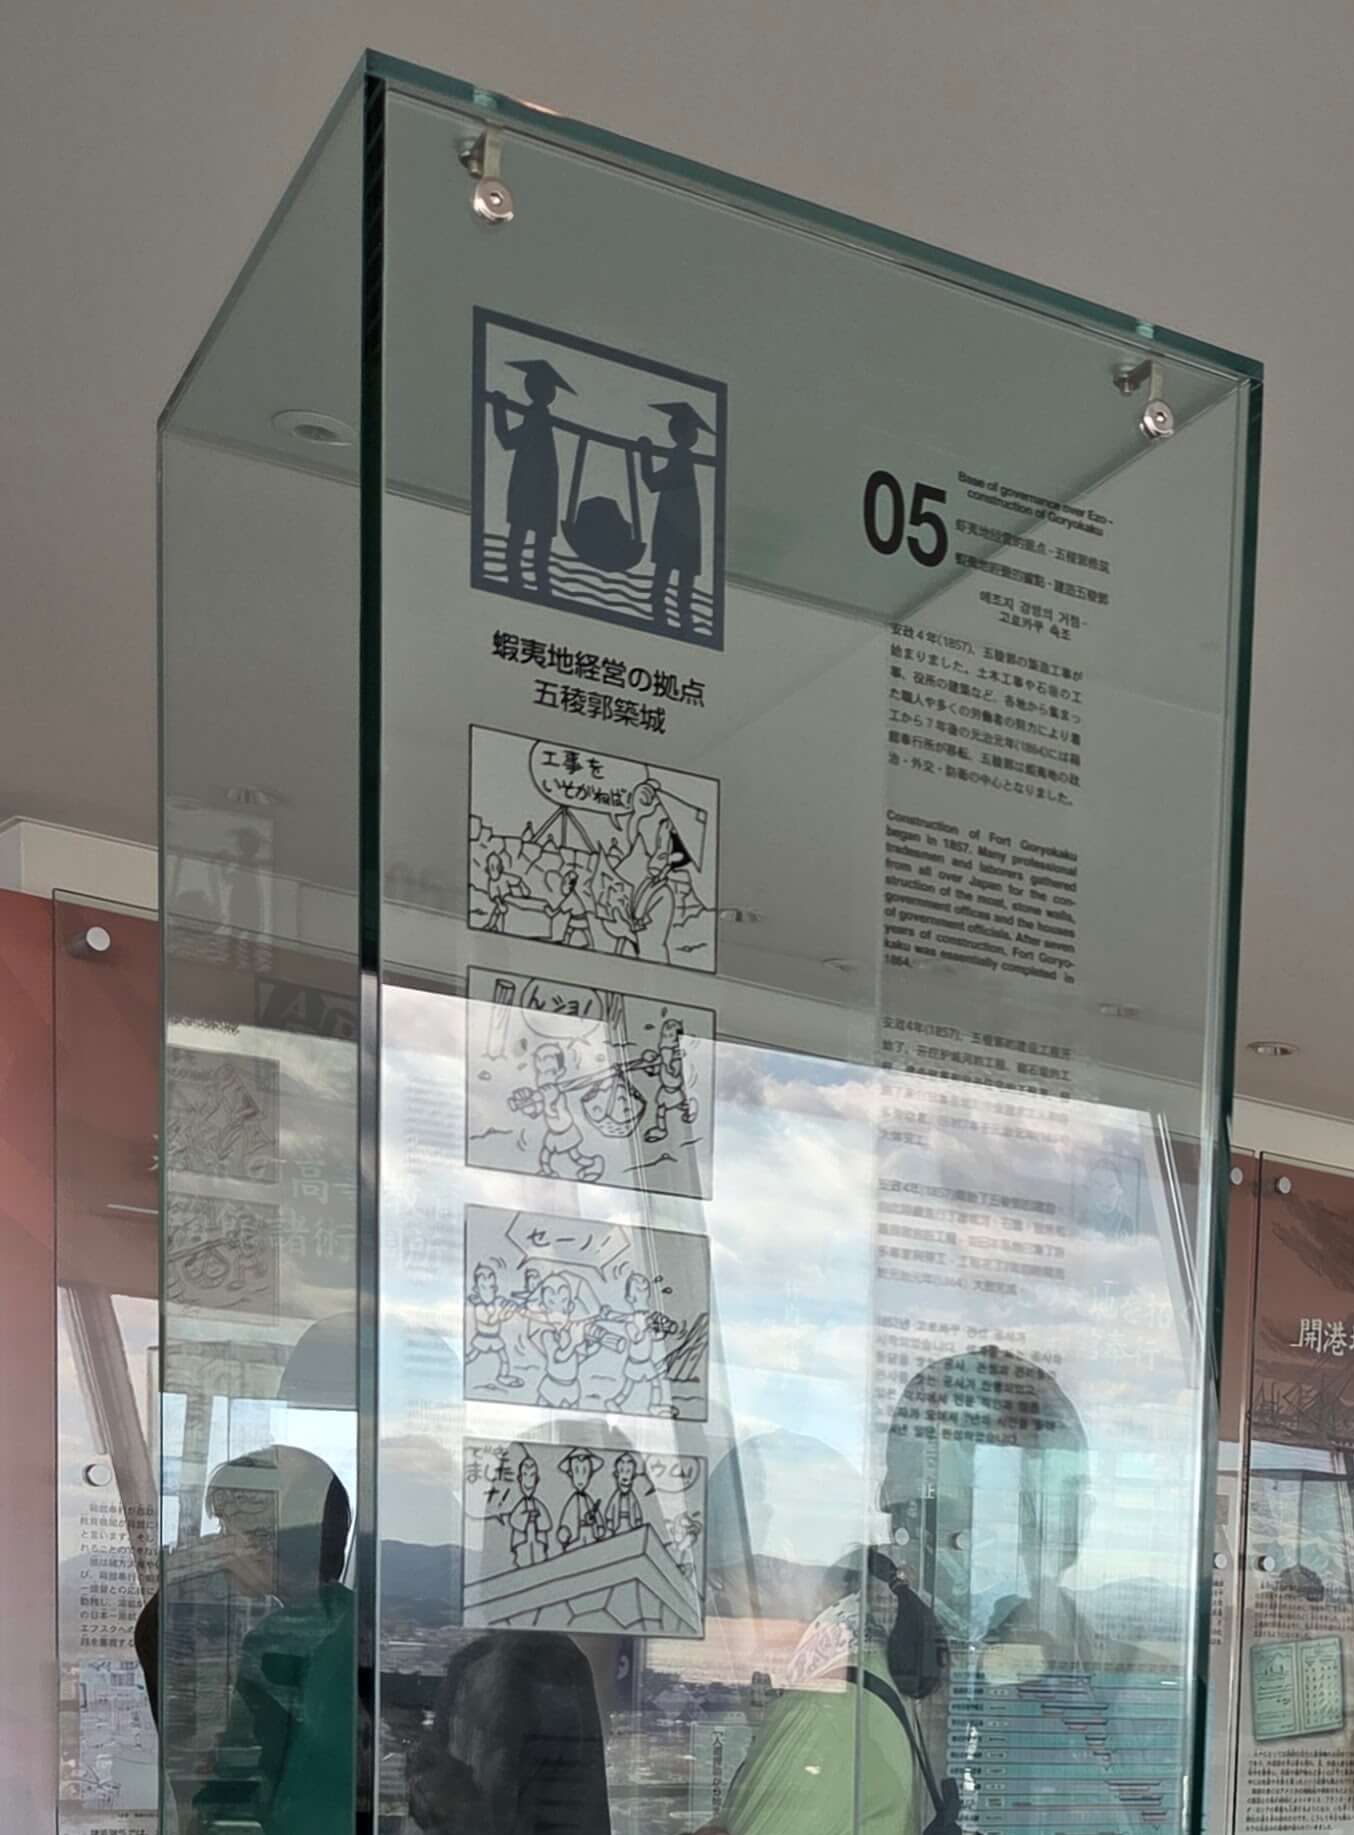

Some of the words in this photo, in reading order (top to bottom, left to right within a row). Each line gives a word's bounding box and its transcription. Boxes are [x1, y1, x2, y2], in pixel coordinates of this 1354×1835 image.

[863, 470, 949, 567] 05
[491, 629, 705, 707] 蝦夷地経営の拠点
[533, 678, 667, 735] 五稜郭築城
[542, 750, 605, 780] 工事を
[885, 808, 960, 836] Construction
[968, 828, 981, 840] of
